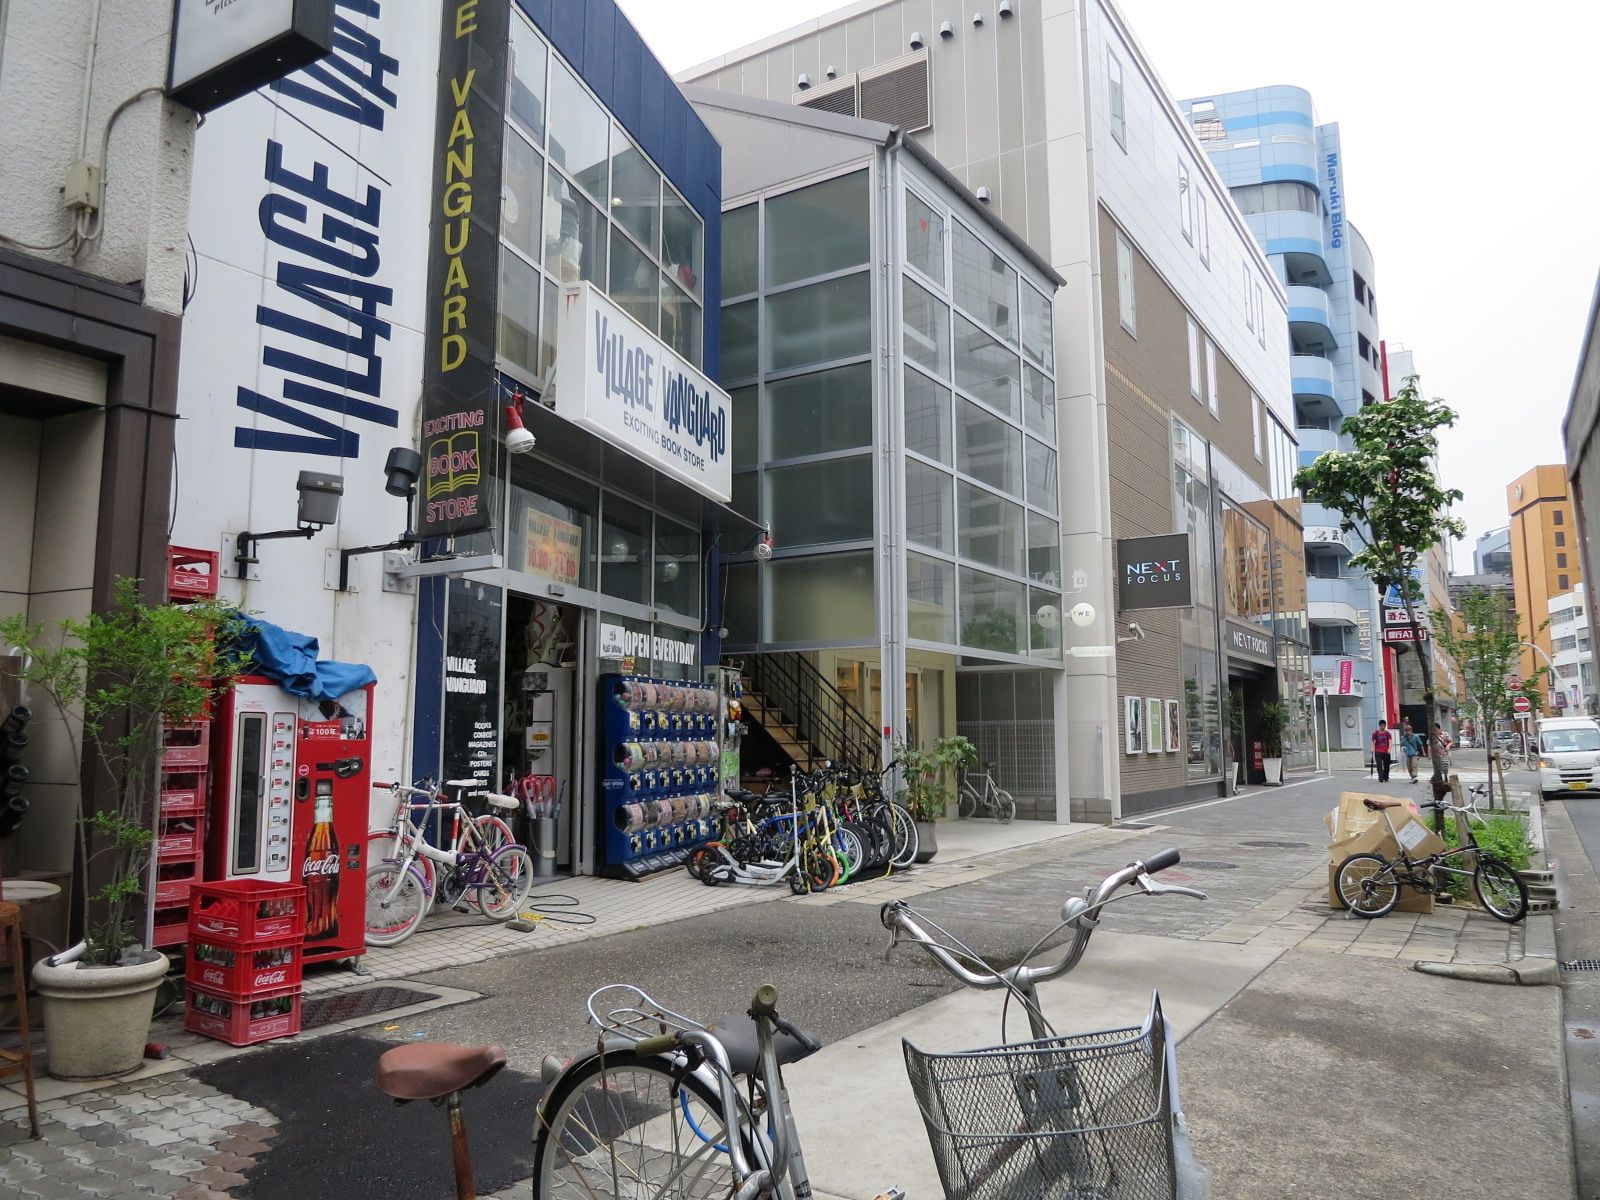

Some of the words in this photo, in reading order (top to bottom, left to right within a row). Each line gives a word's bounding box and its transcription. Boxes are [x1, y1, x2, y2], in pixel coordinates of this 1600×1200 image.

[1327, 153, 1341, 211] Maruki
[441, 69, 476, 373] VANGUARD
[1331, 212, 1343, 249] Bldg
[234, 139, 399, 459] VILLAGE
[595, 310, 654, 412] VILLAGE
[663, 366, 726, 463] VANGUARD
[424, 409, 485, 437] EXCITING
[623, 411, 660, 444] EXCITING
[661, 435, 682, 459] BOOK
[683, 448, 705, 472] STORE
[430, 449, 478, 477] BOOK
[426, 495, 479, 523] STORE
[1127, 560, 1180, 575] NEXT
[1127, 573, 1181, 585] FOCUS
[625, 630, 650, 659] OPEN
[653, 636, 695, 666] EVERYDAY
[1232, 630, 1251, 650] NEXT
[1251, 636, 1268, 656] FOCUS
[446, 656, 476, 674] VILLAGE
[446, 676, 487, 695] VANGUARD
[473, 731, 493, 739] COMICS
[474, 722, 492, 730] BOOKS
[470, 760, 493, 768] POSTERS
[473, 769, 490, 778] CARDS
